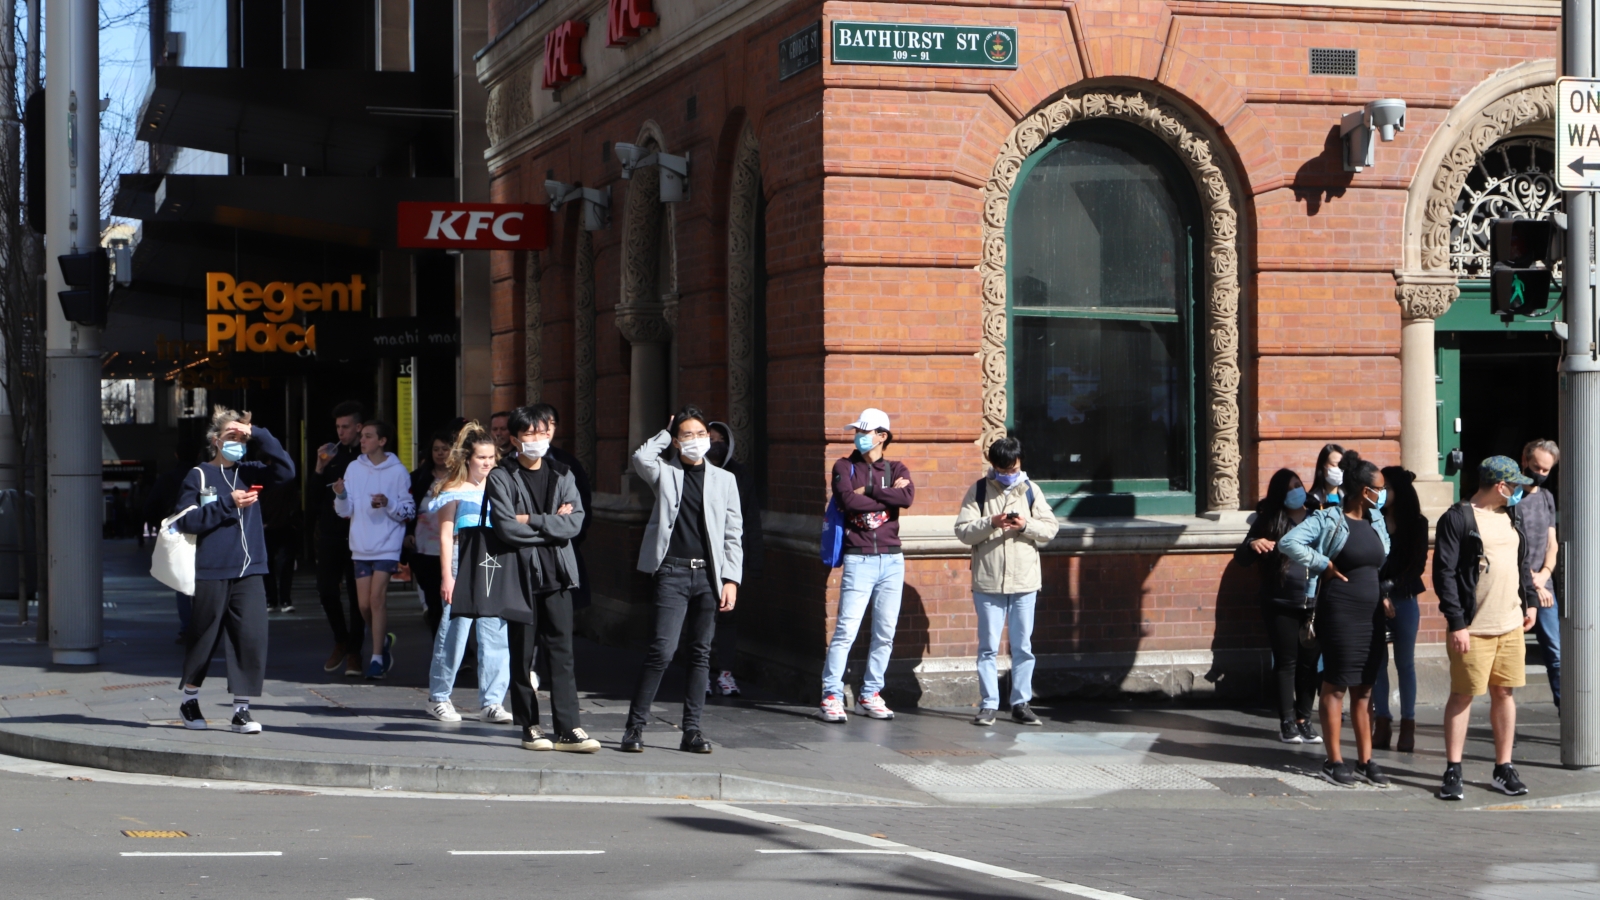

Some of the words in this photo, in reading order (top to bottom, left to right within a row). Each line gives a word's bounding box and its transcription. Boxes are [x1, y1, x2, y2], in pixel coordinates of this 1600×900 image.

[838, 28, 945, 50] BATHURST
[956, 33, 980, 51] ST
[542, 19, 577, 89] KFC
[892, 50, 908, 60] 109
[920, 51, 930, 61] 91
[1570, 90, 1600, 113] ON
[1568, 124, 1600, 146] WA
[423, 210, 524, 242] KFC
[206, 272, 366, 323] Regent
[373, 328, 420, 346] machi
[427, 332, 457, 344] mac
